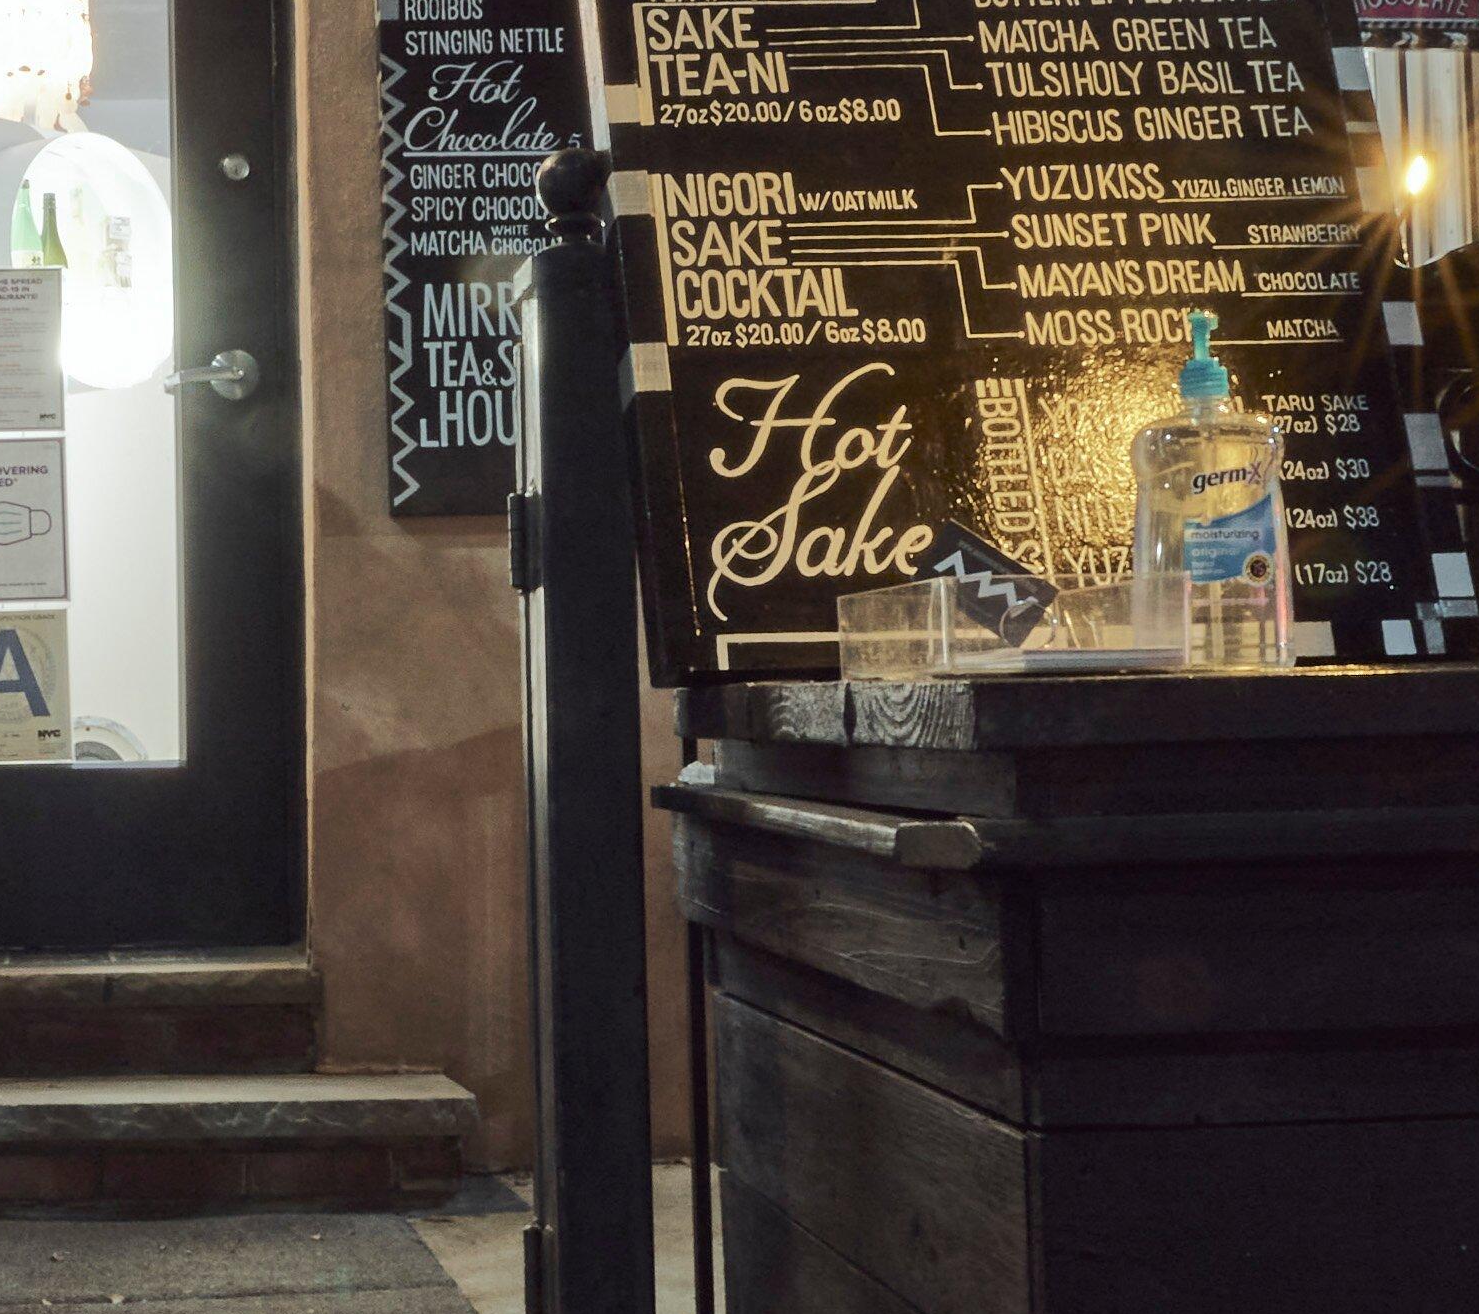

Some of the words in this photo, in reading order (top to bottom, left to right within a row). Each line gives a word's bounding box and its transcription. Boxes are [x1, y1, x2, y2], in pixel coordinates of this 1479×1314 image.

[405, 29, 493, 55] STINGING
[500, 28, 564, 53] NETTLE
[647, 7, 759, 50] SAKE
[979, 19, 1099, 54] MATCHA
[1112, 18, 1210, 52] GREEN
[1219, 17, 1277, 48] TEA
[428, 60, 524, 104] Hot
[649, 52, 790, 96] TEA-NI
[1156, 61, 1245, 95] BASIL
[1247, 60, 1305, 92] TEA
[404, 97, 561, 151] Chocolate
[992, 109, 1122, 145] HIBISCUS
[1135, 106, 1245, 141] GINGER
[1250, 104, 1314, 136] TEA
[410, 164, 476, 190] GINGER
[664, 172, 797, 217] NIGORI
[411, 196, 467, 222] SPICY
[411, 231, 487, 256] MATCHA
[491, 225, 529, 235] WHITE
[671, 220, 789, 267] SAKE
[1012, 213, 1129, 250] SUNSET
[1139, 213, 1216, 246] PINK
[1248, 224, 1362, 244] STRAWBERRY
[677, 267, 858, 320] COCKTAIL
[1017, 261, 1144, 298] MAYAN'S
[1146, 259, 1247, 295] DREAM
[1257, 272, 1360, 292] CHOCOLATE
[1024, 309, 1115, 346] MOSS
[1267, 319, 1338, 339] MATCHA
[708, 362, 913, 478] Hot
[1262, 395, 1314, 412] TARU
[1321, 394, 1369, 411] SAKE
[1325, 414, 1361, 435] $28
[1335, 458, 1370, 481] $30
[1286, 508, 1338, 529] (24oz)
[1344, 504, 1380, 530] $38
[707, 464, 934, 622] Sake
[1295, 563, 1348, 585] (17oz)
[1355, 560, 1393, 584] $28
